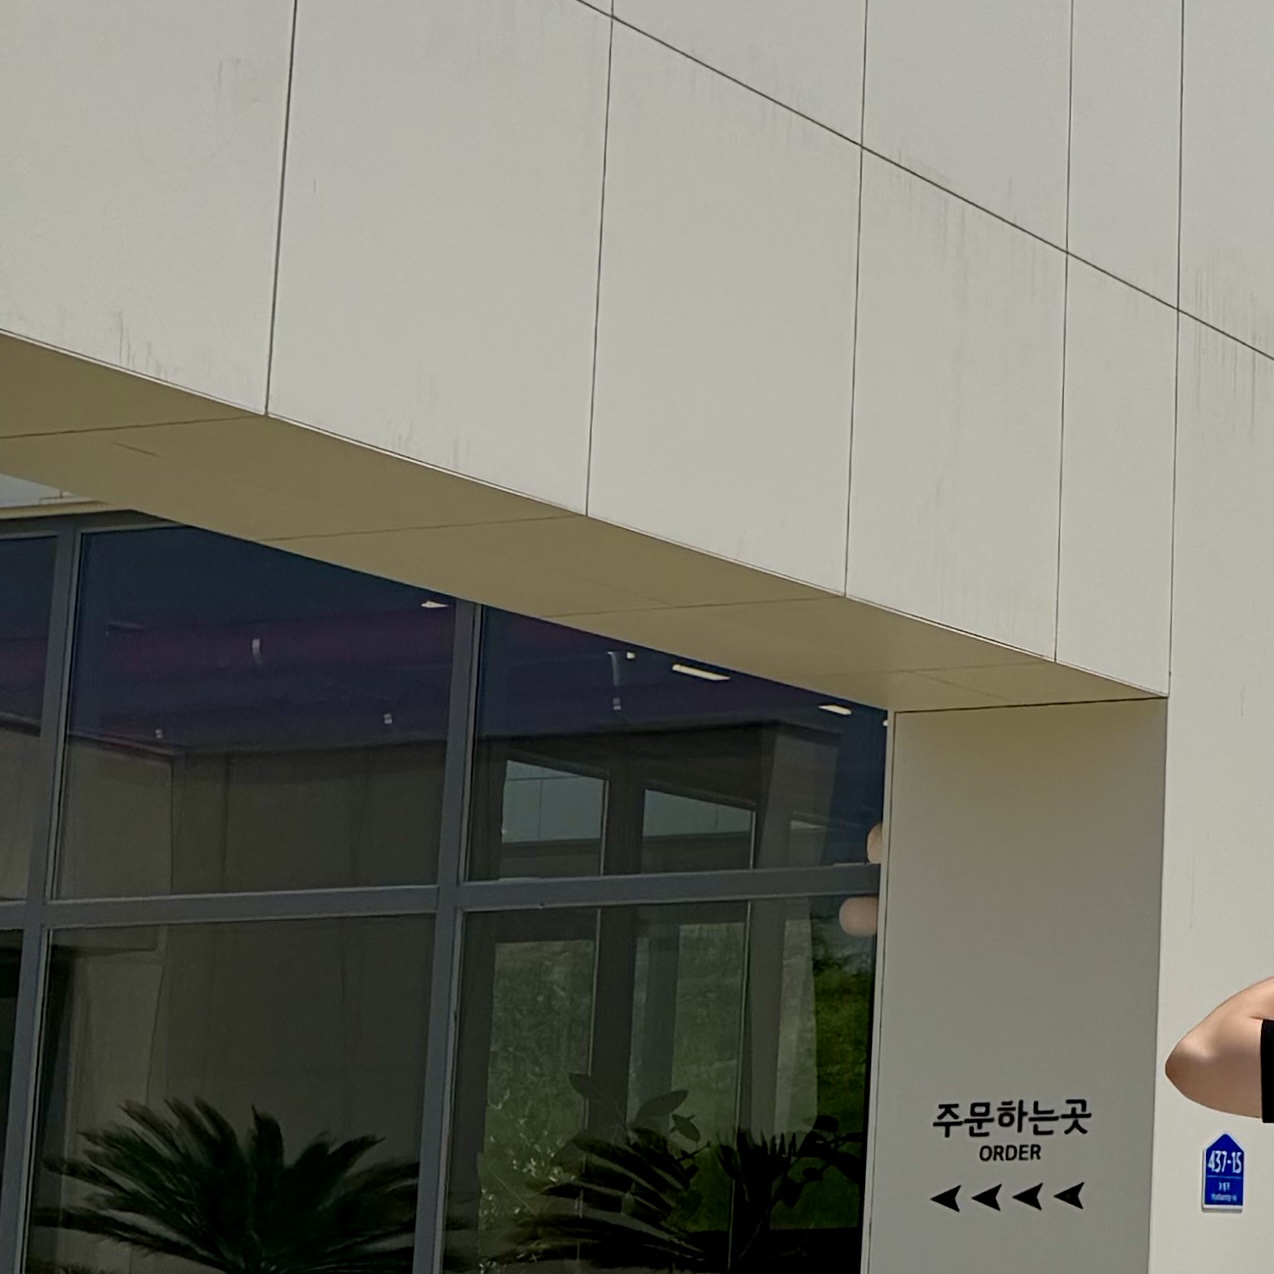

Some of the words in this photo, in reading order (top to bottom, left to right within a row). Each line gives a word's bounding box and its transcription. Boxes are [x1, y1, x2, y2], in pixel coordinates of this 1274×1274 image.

[932, 1099, 1092, 1138] 주문하는곳
[979, 1144, 1042, 1162] ORDER
[1207, 1150, 1242, 1173] 437-15
